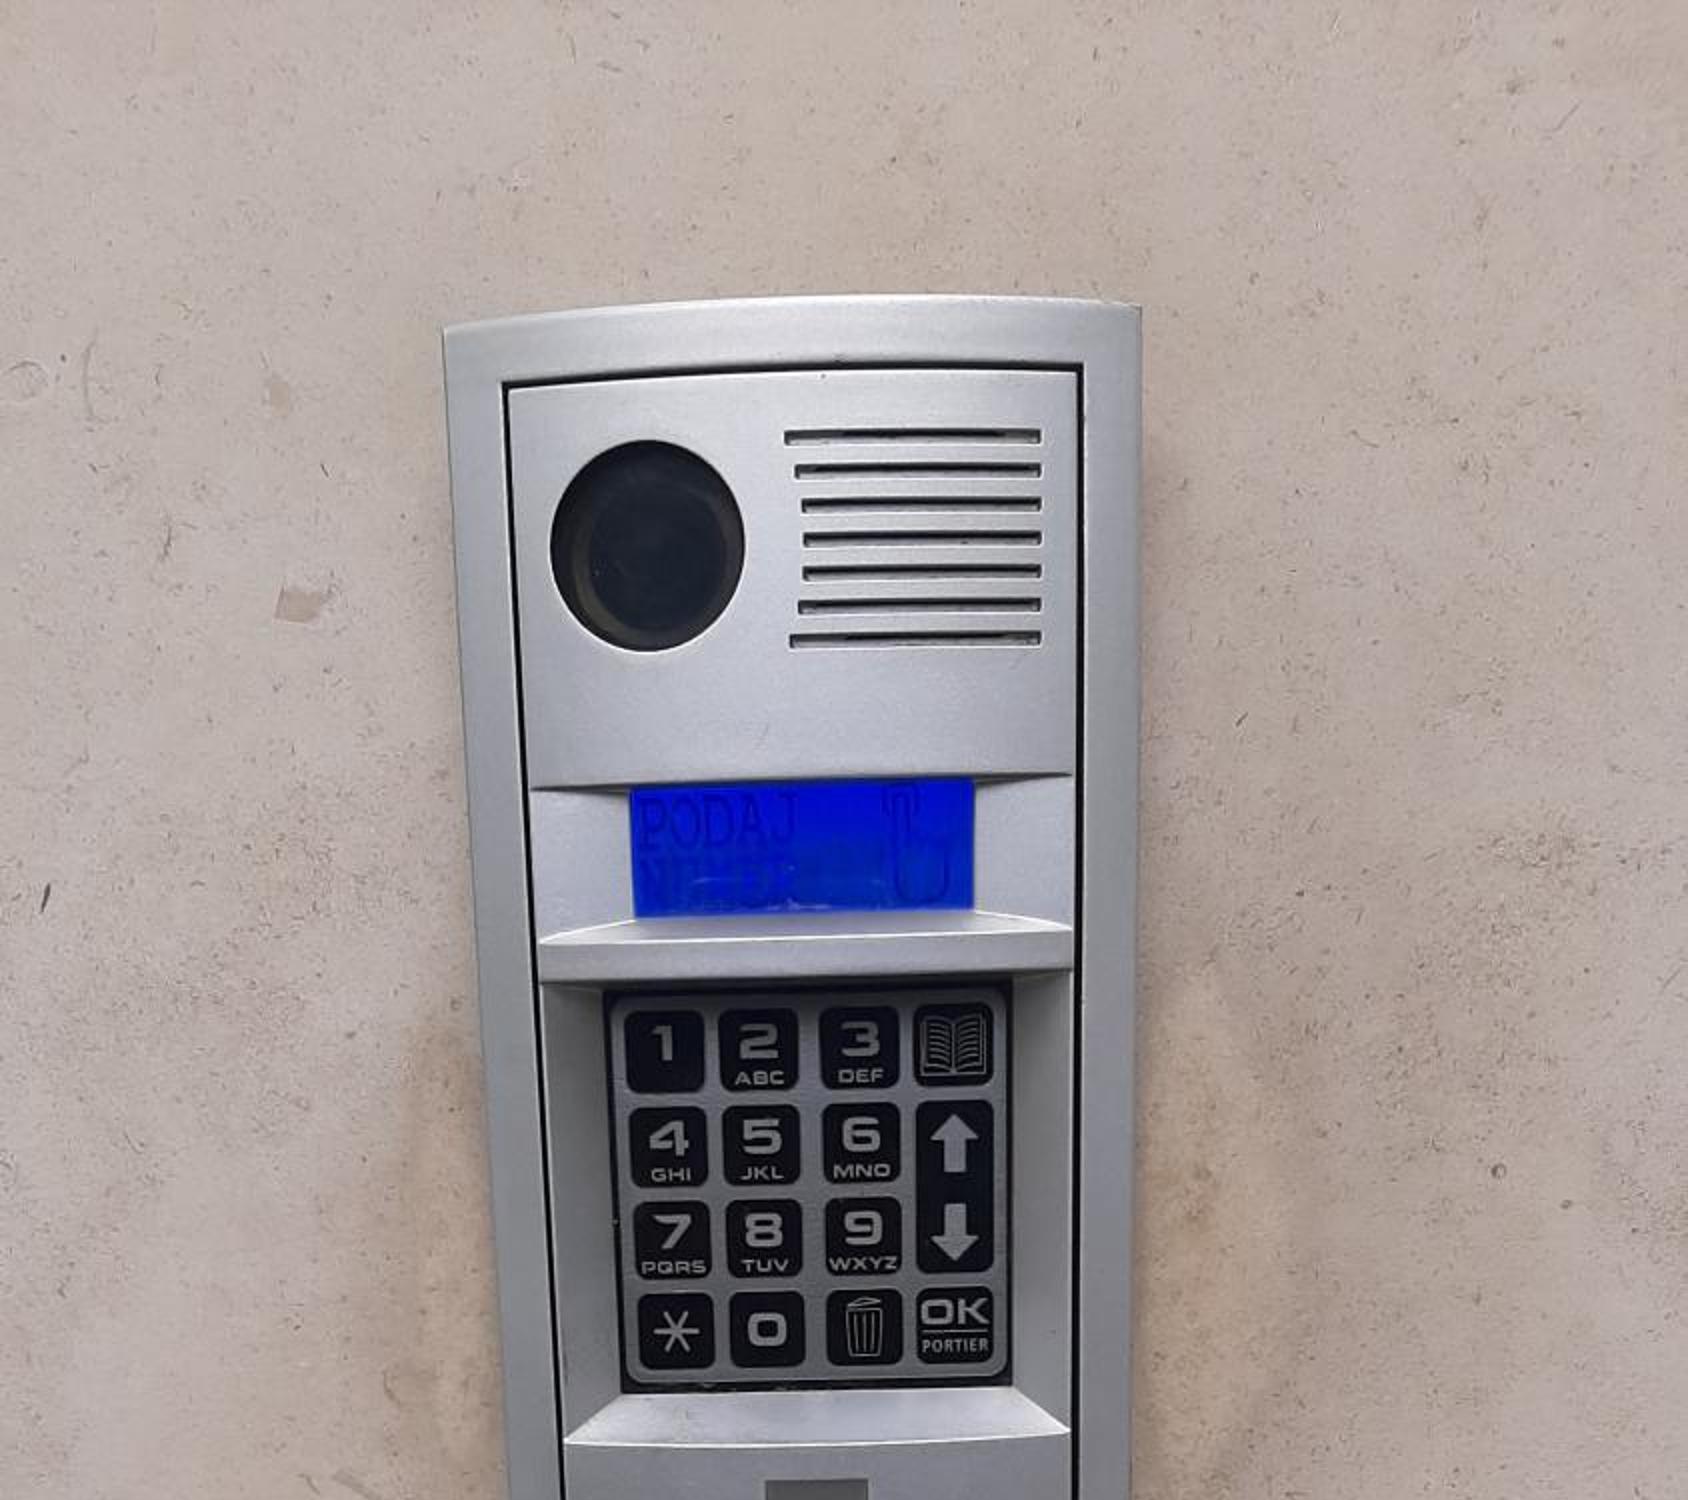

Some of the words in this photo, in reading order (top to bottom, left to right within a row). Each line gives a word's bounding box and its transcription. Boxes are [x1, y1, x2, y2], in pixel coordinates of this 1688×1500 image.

[651, 1024, 673, 1061] 1
[738, 1023, 780, 1060] 2
[840, 1020, 881, 1058] 3
[734, 1071, 785, 1086] ABC
[838, 1068, 884, 1083] DEF
[649, 1119, 689, 1157] 4
[742, 1118, 783, 1155] 5
[841, 1116, 881, 1153] 6
[650, 1167, 692, 1182] GHI
[740, 1165, 784, 1180] JKL
[833, 1164, 891, 1178] MNO
[652, 1213, 692, 1250] 7
[744, 1212, 783, 1248] 8
[843, 1209, 883, 1246] 9
[641, 1260, 707, 1275] PQRS
[740, 1259, 789, 1273] TUV
[829, 1256, 898, 1271] WXYZ
[920, 1297, 990, 1325] OK
[922, 1337, 989, 1353] PORTIER
